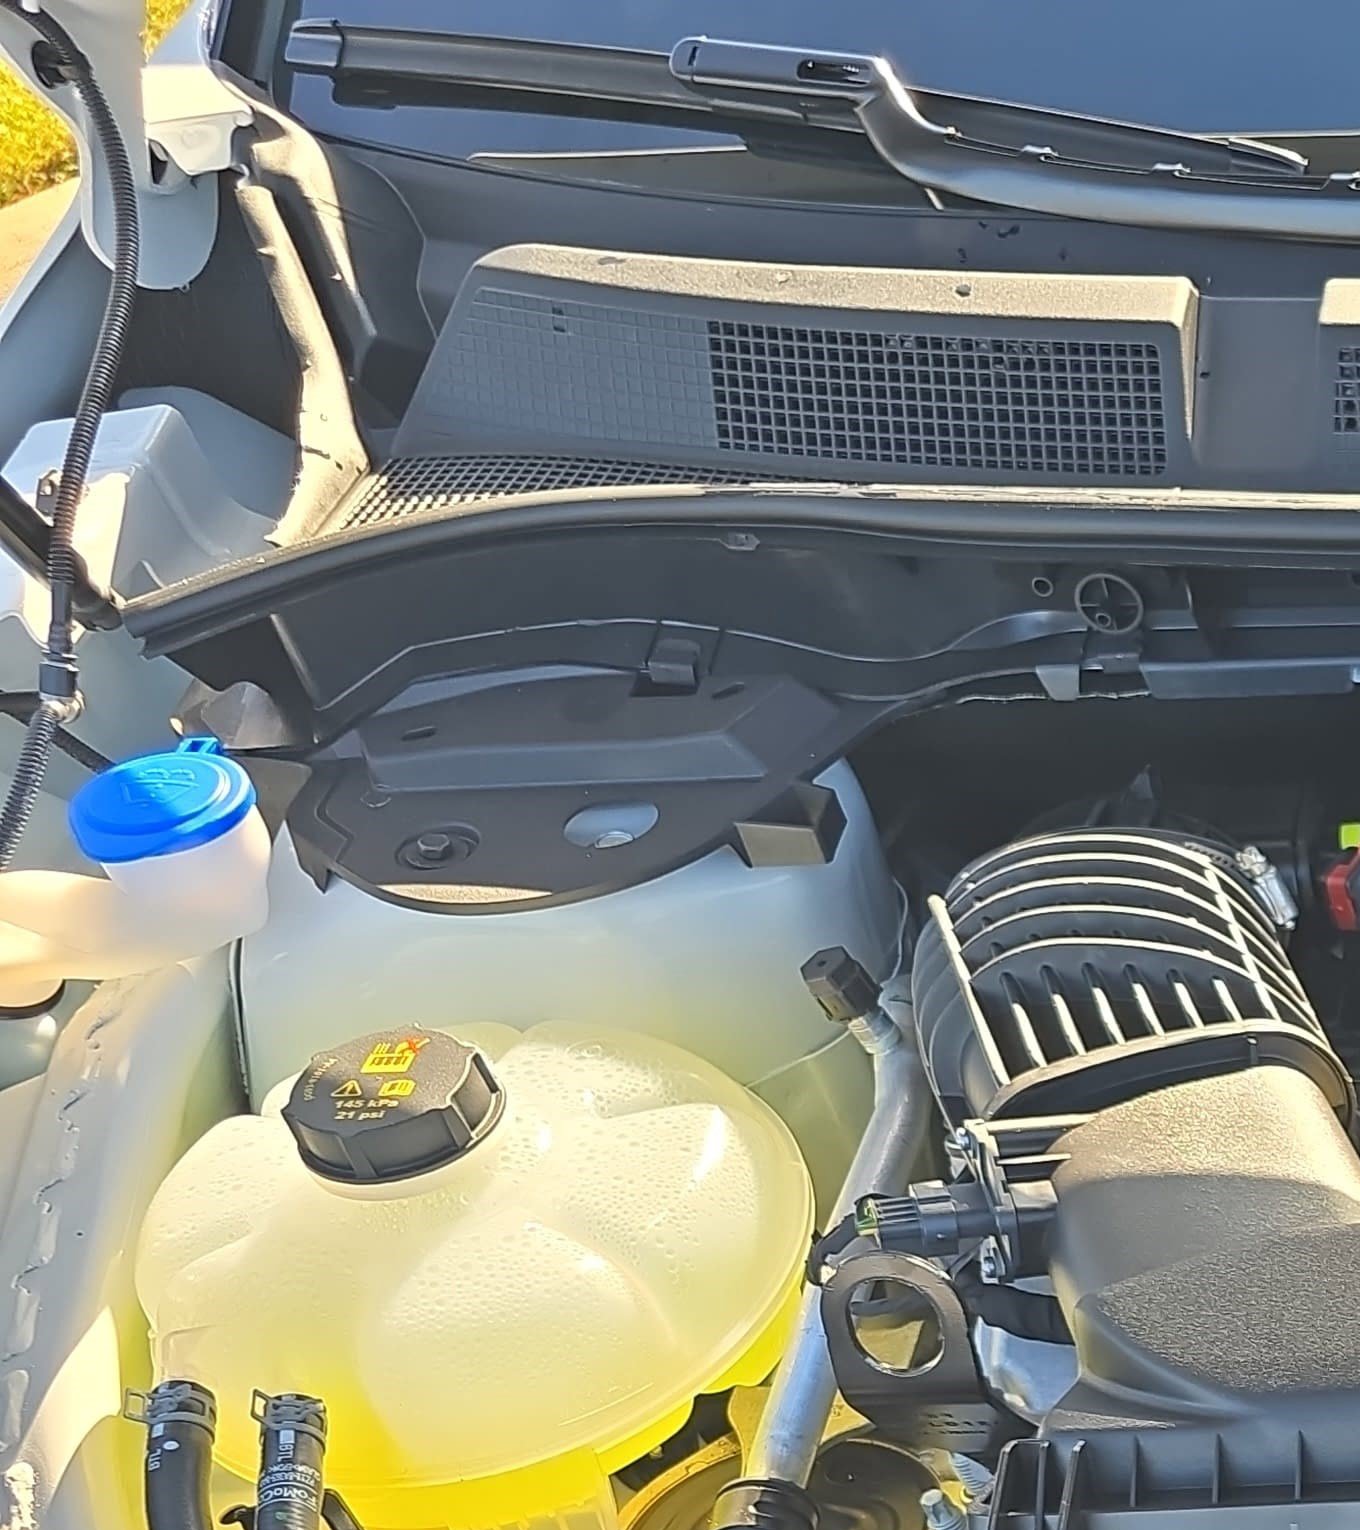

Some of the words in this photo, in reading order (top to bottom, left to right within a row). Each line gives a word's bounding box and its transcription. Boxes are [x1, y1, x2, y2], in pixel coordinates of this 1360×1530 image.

[335, 1099, 366, 1109] 145
[367, 1098, 400, 1109] kPa
[334, 1110, 356, 1120] 21
[358, 1110, 385, 1121] psi
[277, 1442, 295, 1463] BTL
[259, 1487, 318, 1506] FoMoC
